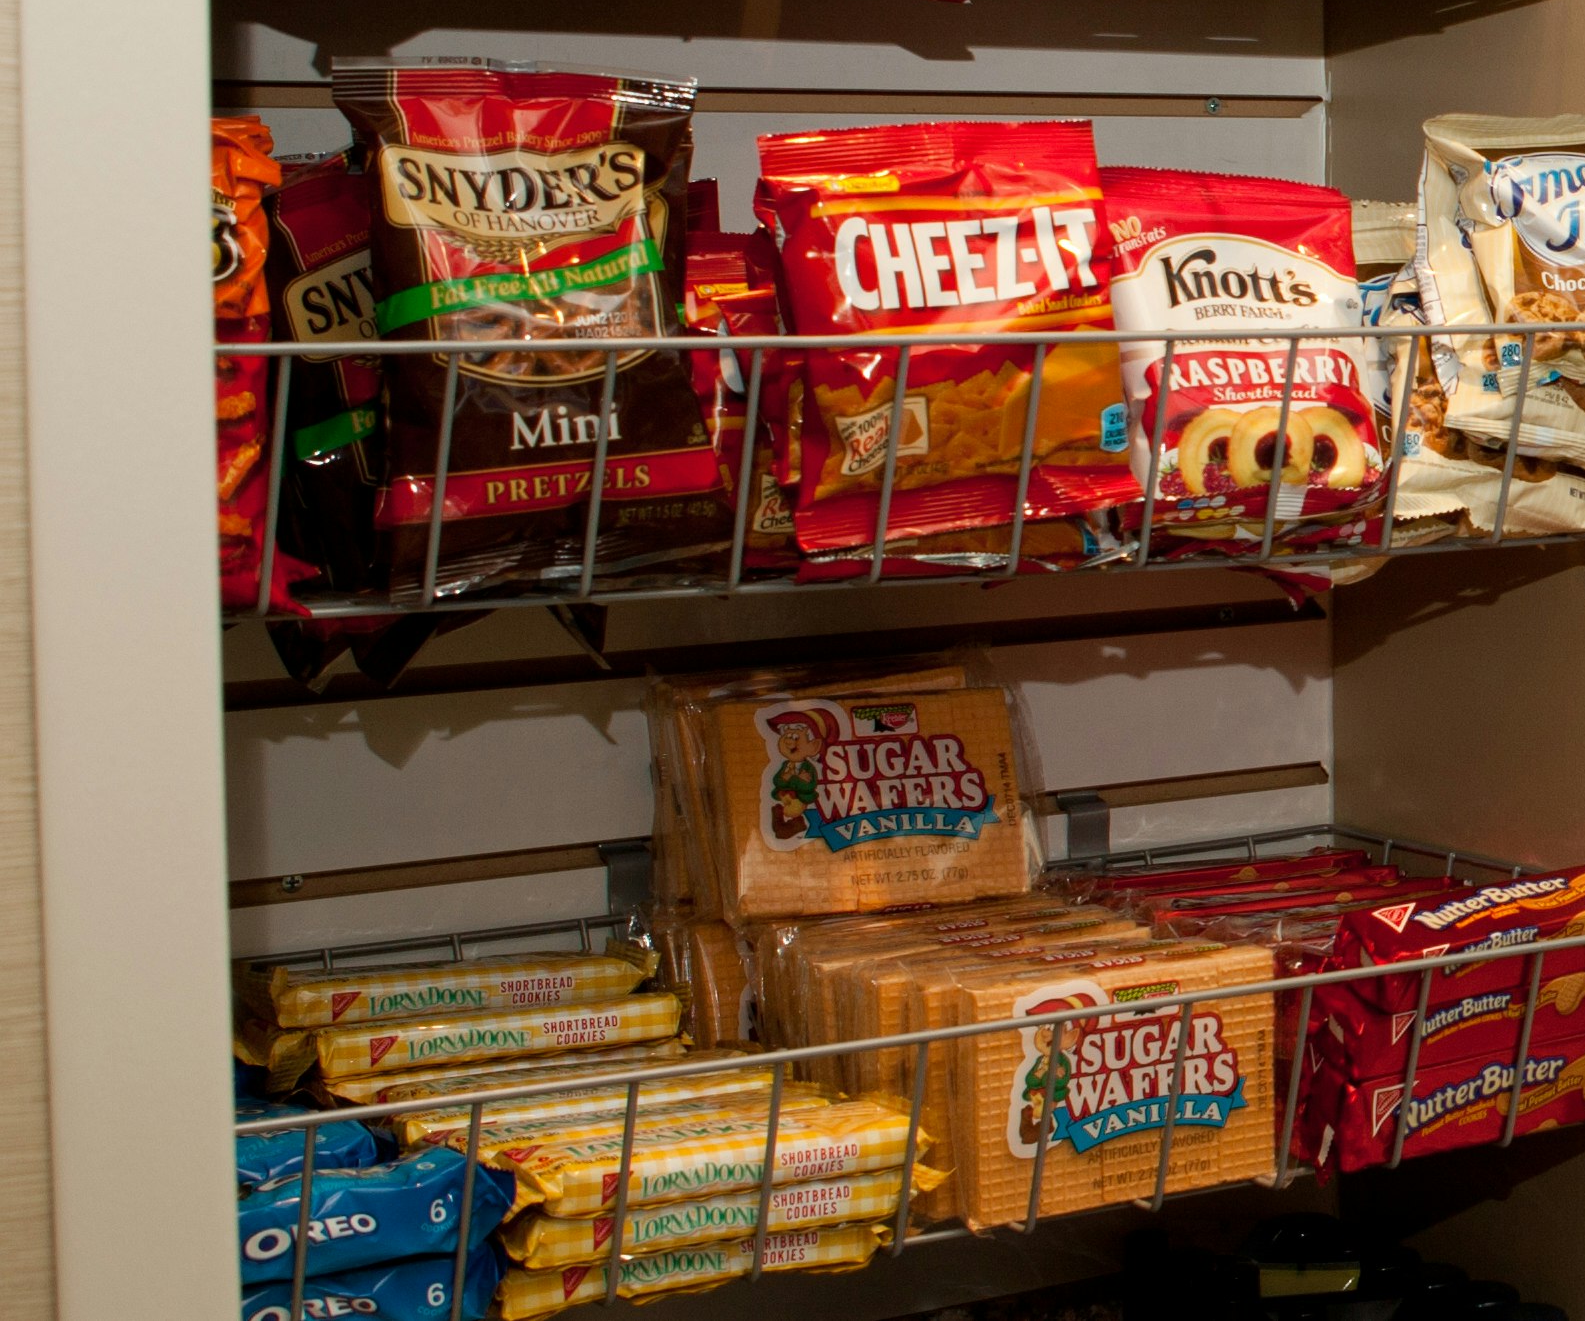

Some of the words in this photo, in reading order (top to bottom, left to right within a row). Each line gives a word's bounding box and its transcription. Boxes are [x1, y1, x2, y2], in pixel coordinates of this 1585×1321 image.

[397, 150, 643, 214] SNYDER'S
[452, 210, 482, 229] OF
[486, 210, 602, 232] HANOVER
[1109, 215, 1142, 244] NO
[834, 205, 1098, 311] CHEEZ-IT
[430, 280, 472, 310] Fat
[564, 245, 650, 286] Natural
[1159, 248, 1320, 309] Knott's
[1194, 304, 1238, 321] BERRY
[1240, 304, 1284, 321] FARM
[1501, 343, 1520, 359] 280
[1161, 355, 1353, 392] RASPBERRY
[1213, 386, 1320, 404] Shortbrad
[510, 402, 623, 450] Mini
[824, 737, 967, 782] SUGAR
[816, 772, 984, 820] WAFERS
[835, 813, 977, 841] VANILLA
[843, 845, 913, 862] ARTIFICIALLY
[1414, 877, 1567, 930] NutterButter
[500, 976, 574, 994] SHORTBREAD
[512, 989, 562, 1005] COOKIES
[542, 1015, 619, 1035] SHORTBREAD
[556, 1030, 606, 1046] COOKIES
[1081, 1016, 1223, 1074] SUGAR
[781, 1143, 859, 1167] SHORTBREAD
[793, 1159, 845, 1178] COOKIES
[772, 1185, 851, 1209] SHORTBREAD
[786, 1201, 838, 1221] COOKIES
[244, 1213, 377, 1262] OREO
[430, 1198, 447, 1224] 6
[427, 1282, 446, 1307] 6
